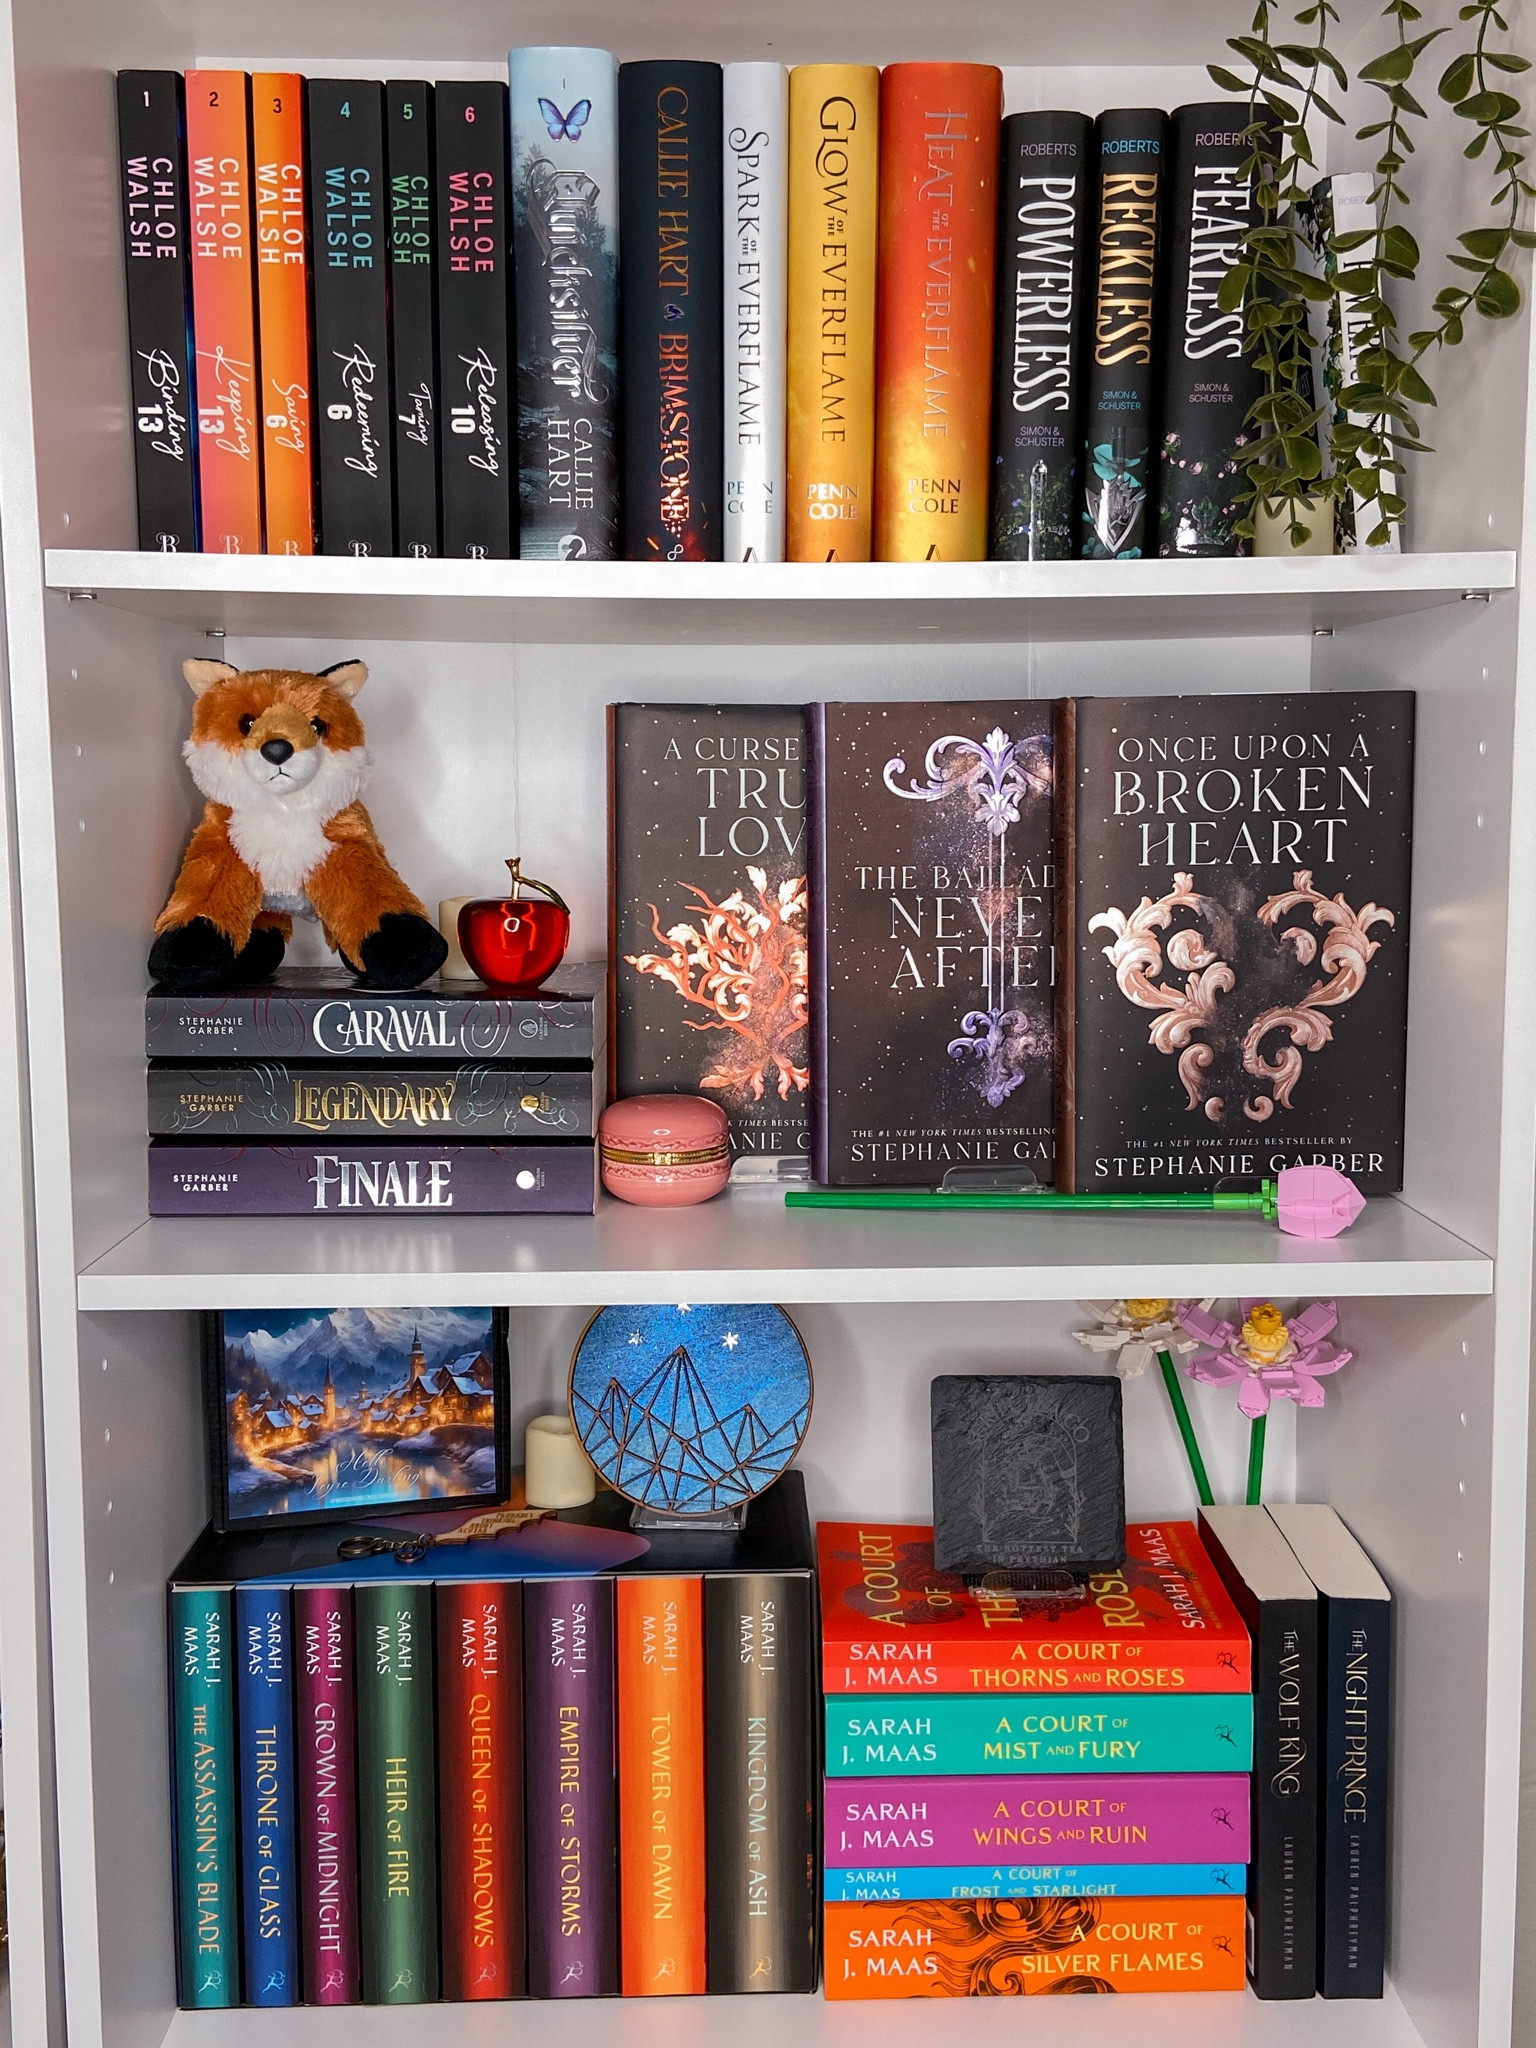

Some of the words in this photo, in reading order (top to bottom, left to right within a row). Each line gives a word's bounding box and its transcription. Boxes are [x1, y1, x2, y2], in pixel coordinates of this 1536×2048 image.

[143, 91, 150, 107] 1
[209, 92, 219, 107] 2
[273, 98, 283, 114] 3
[340, 102, 351, 118] 4
[403, 104, 413, 120] 5
[465, 107, 475, 123] 6
[657, 86, 689, 198] CALLIE
[815, 96, 858, 217] GLOW
[917, 108, 968, 207] HEAT
[1020, 143, 1077, 157] ROBERTS
[1101, 140, 1160, 155] ROBERTS
[729, 127, 769, 237] SPARK
[127, 157, 151, 258] WALSH
[152, 158, 177, 259] CHLOE
[194, 157, 217, 258] WALSH
[219, 158, 242, 259] CHLOE
[449, 172, 471, 272] WALSH
[473, 173, 494, 273] CHLOE
[836, 220, 844, 235] OF
[933, 209, 941, 230] THE
[941, 213, 949, 227] OF
[658, 209, 691, 296] HART
[750, 239, 757, 256] OF
[1094, 173, 1158, 366] RECKLESS
[1183, 165, 1252, 360] FEARLESS
[527, 159, 603, 403] Quicksilver
[1012, 175, 1076, 413] POWERLESS
[738, 262, 761, 445] EVERFLAME
[822, 243, 847, 442] EVERFLAME
[923, 237, 952, 438] EVERFLAME
[137, 349, 184, 461] Binding
[195, 346, 251, 461] Keeping
[272, 379, 306, 453] Saving
[327, 404, 352, 420] 6
[333, 343, 379, 479] Redeeming
[399, 413, 416, 424] 7
[409, 382, 433, 446] Taming
[458, 348, 499, 477] Releasing
[1097, 401, 1141, 411] SCHUSTER
[1102, 390, 1127, 400] SIMON
[138, 406, 163, 433] 13
[199, 407, 224, 433] 13
[265, 416, 288, 428] 6
[451, 405, 475, 434] 10
[658, 334, 690, 521] BRIMSTONE
[1015, 436, 1065, 448] SCHUSTER
[1020, 426, 1050, 437] SIMON
[547, 419, 571, 509] HART
[573, 418, 594, 509] CALLIE
[908, 478, 962, 494] PENN
[807, 483, 859, 501] PENN
[808, 503, 858, 521] COLE
[911, 498, 960, 514] COLE
[664, 739, 682, 760] A
[694, 738, 799, 761] CURSE
[1118, 736, 1216, 762] ONCE
[1234, 733, 1331, 760] UPON
[1350, 733, 1369, 757] A
[1113, 765, 1374, 815] BROKEN
[1138, 818, 1347, 866] HEART
[855, 866, 916, 890] THE
[179, 1017, 243, 1026] STEPHANIE
[188, 1026, 234, 1035] GARBER
[312, 1001, 456, 1054] CARAVAL
[180, 1094, 244, 1104] STEPHANIE
[189, 1103, 235, 1112] GARBER
[291, 1079, 457, 1131] LEGENDARY
[851, 1129, 873, 1138] THE
[878, 1129, 890, 1138] #1
[896, 1128, 917, 1137] NEW
[920, 1128, 947, 1137] YORK
[952, 1128, 982, 1136] TIMES
[851, 1141, 999, 1162] STEPHANIE
[1126, 1139, 1148, 1148] THE
[1153, 1139, 1164, 1148] #1
[1169, 1138, 1192, 1148] NEW
[1196, 1138, 1223, 1147] YORK
[1228, 1138, 1260, 1146] TIMES
[1264, 1137, 1335, 1146] BESTSELLER
[1340, 1136, 1352, 1145] BY
[173, 1173, 238, 1183] STEPHANIE
[183, 1183, 229, 1192] GARBER
[307, 1155, 453, 1209] FINALE
[1094, 1154, 1254, 1177] STEPHANIE
[859, 1531, 899, 1603] COURT
[1004, 1545, 1057, 1553] HOTTEST
[1009, 1555, 1068, 1564] PRYTHIAN
[1140, 1529, 1175, 1566] MAAS
[1163, 1584, 1205, 1628] SARAH
[184, 1626, 199, 1676] MAAS
[205, 1612, 221, 1670] SARAH
[248, 1626, 263, 1675] MAAS
[267, 1612, 282, 1669] SARAH
[306, 1625, 320, 1674] MAAS
[326, 1611, 341, 1669] SARAH
[849, 1643, 932, 1660] SARAH
[1037, 1643, 1122, 1660] COURT
[1283, 1629, 1299, 1652] THE
[1351, 1629, 1367, 1651] THE
[867, 1667, 938, 1685] MAAS
[970, 1669, 1069, 1687] THORNS
[1105, 1668, 1185, 1687] ROSES
[1278, 1654, 1300, 1730] WOLF
[1345, 1653, 1368, 1732] NIGHT
[193, 1704, 207, 1735] THE
[468, 1694, 492, 1779] QUEEN
[848, 1718, 931, 1736] SARAH
[314, 1702, 336, 1798] CROWN
[559, 1706, 579, 1794] EMPIRE
[650, 1712, 671, 1801] TOWER
[865, 1743, 937, 1762] MAAS
[984, 1742, 1041, 1760] MIST
[1079, 1741, 1141, 1759] FURY
[1270, 1737, 1307, 1799] KING
[255, 1725, 279, 1827] THRONE
[385, 1758, 407, 1812] HEIR
[747, 1717, 767, 1834] KINGDOM
[1336, 1734, 1368, 1824] PRINCE
[193, 1742, 217, 1874] ASSASSIN'S
[973, 1827, 1052, 1846] WINGS
[1090, 1826, 1147, 1844] RUIN
[1283, 1836, 1293, 1881] LAUREN
[317, 1831, 342, 1953] MIDNIGHT
[388, 1850, 409, 1898] FIRE
[472, 1823, 494, 1948] SHADOWS
[560, 1837, 581, 1937] STORMS
[653, 1845, 672, 1919] DAWN
[748, 1869, 767, 1917] ASH
[845, 1871, 896, 1883] SARAH
[856, 1888, 901, 1900] MAAS
[952, 1886, 1001, 1898] FROST
[1032, 1884, 1117, 1896] STARLIGHT
[197, 1883, 219, 1954] BLADE
[258, 1866, 281, 1938] GLASS
[1283, 1888, 1294, 1971] PALPHREYMAN
[1021, 1955, 1101, 1974] SILVER
[1109, 1953, 1204, 1972] FLAMES
